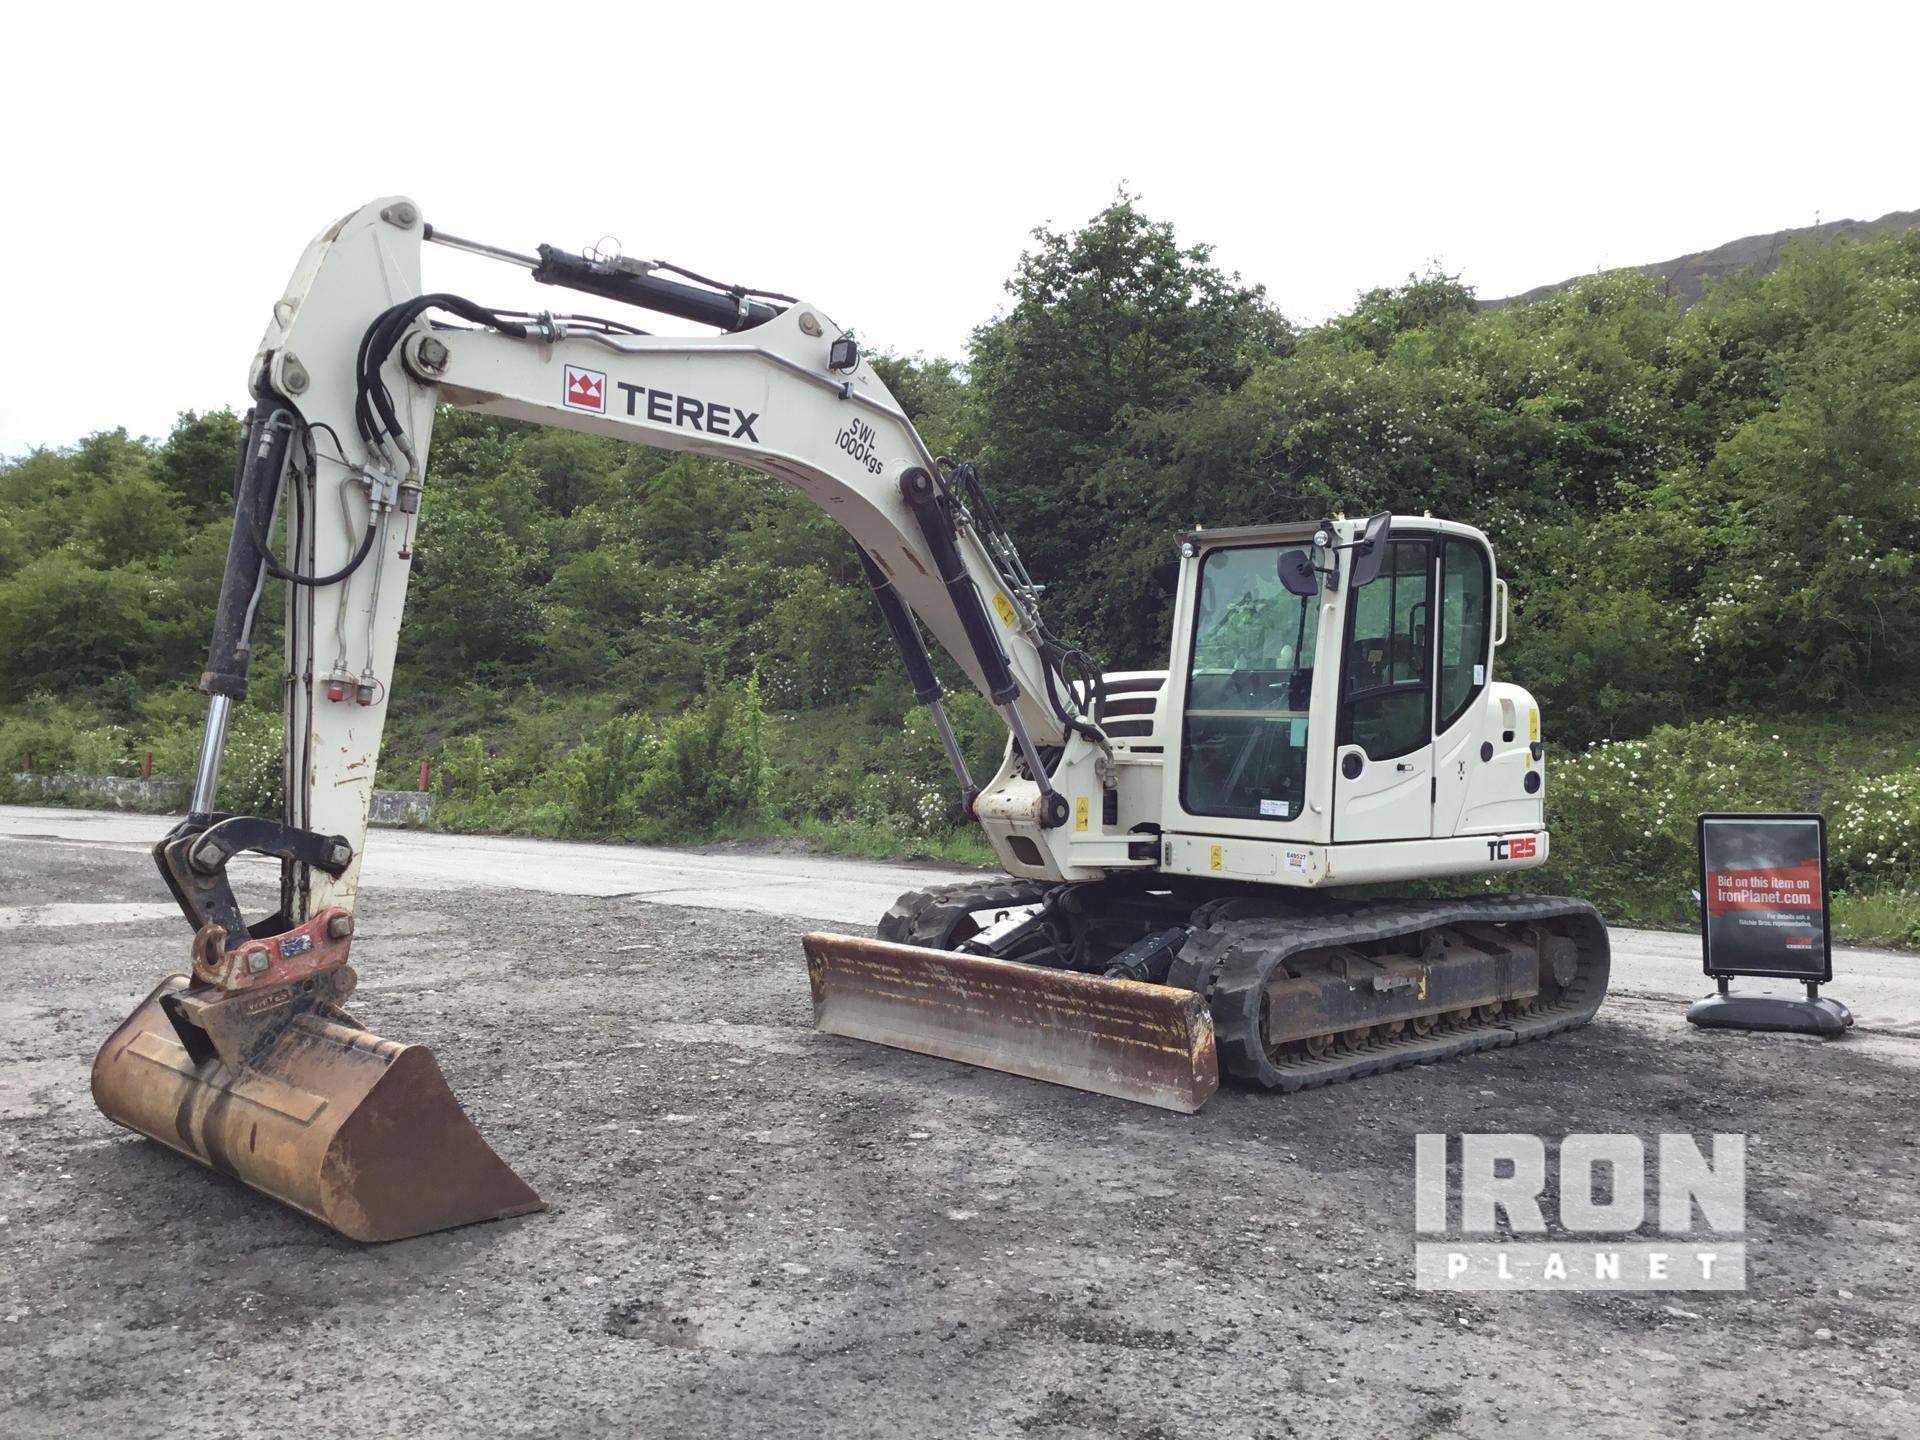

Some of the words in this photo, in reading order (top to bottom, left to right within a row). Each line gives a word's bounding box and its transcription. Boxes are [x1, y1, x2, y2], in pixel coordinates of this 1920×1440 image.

[617, 381, 760, 443] TEREX
[849, 417, 876, 450] SWL
[834, 427, 884, 475] 1000kgs
[1487, 837, 1537, 861] TC125
[1718, 876, 1732, 887] Bid
[1735, 878, 1748, 888] on
[1750, 876, 1769, 888] this
[1771, 877, 1794, 889] item
[1796, 879, 1810, 889] on
[1718, 888, 1811, 904] IronPlanet.com
